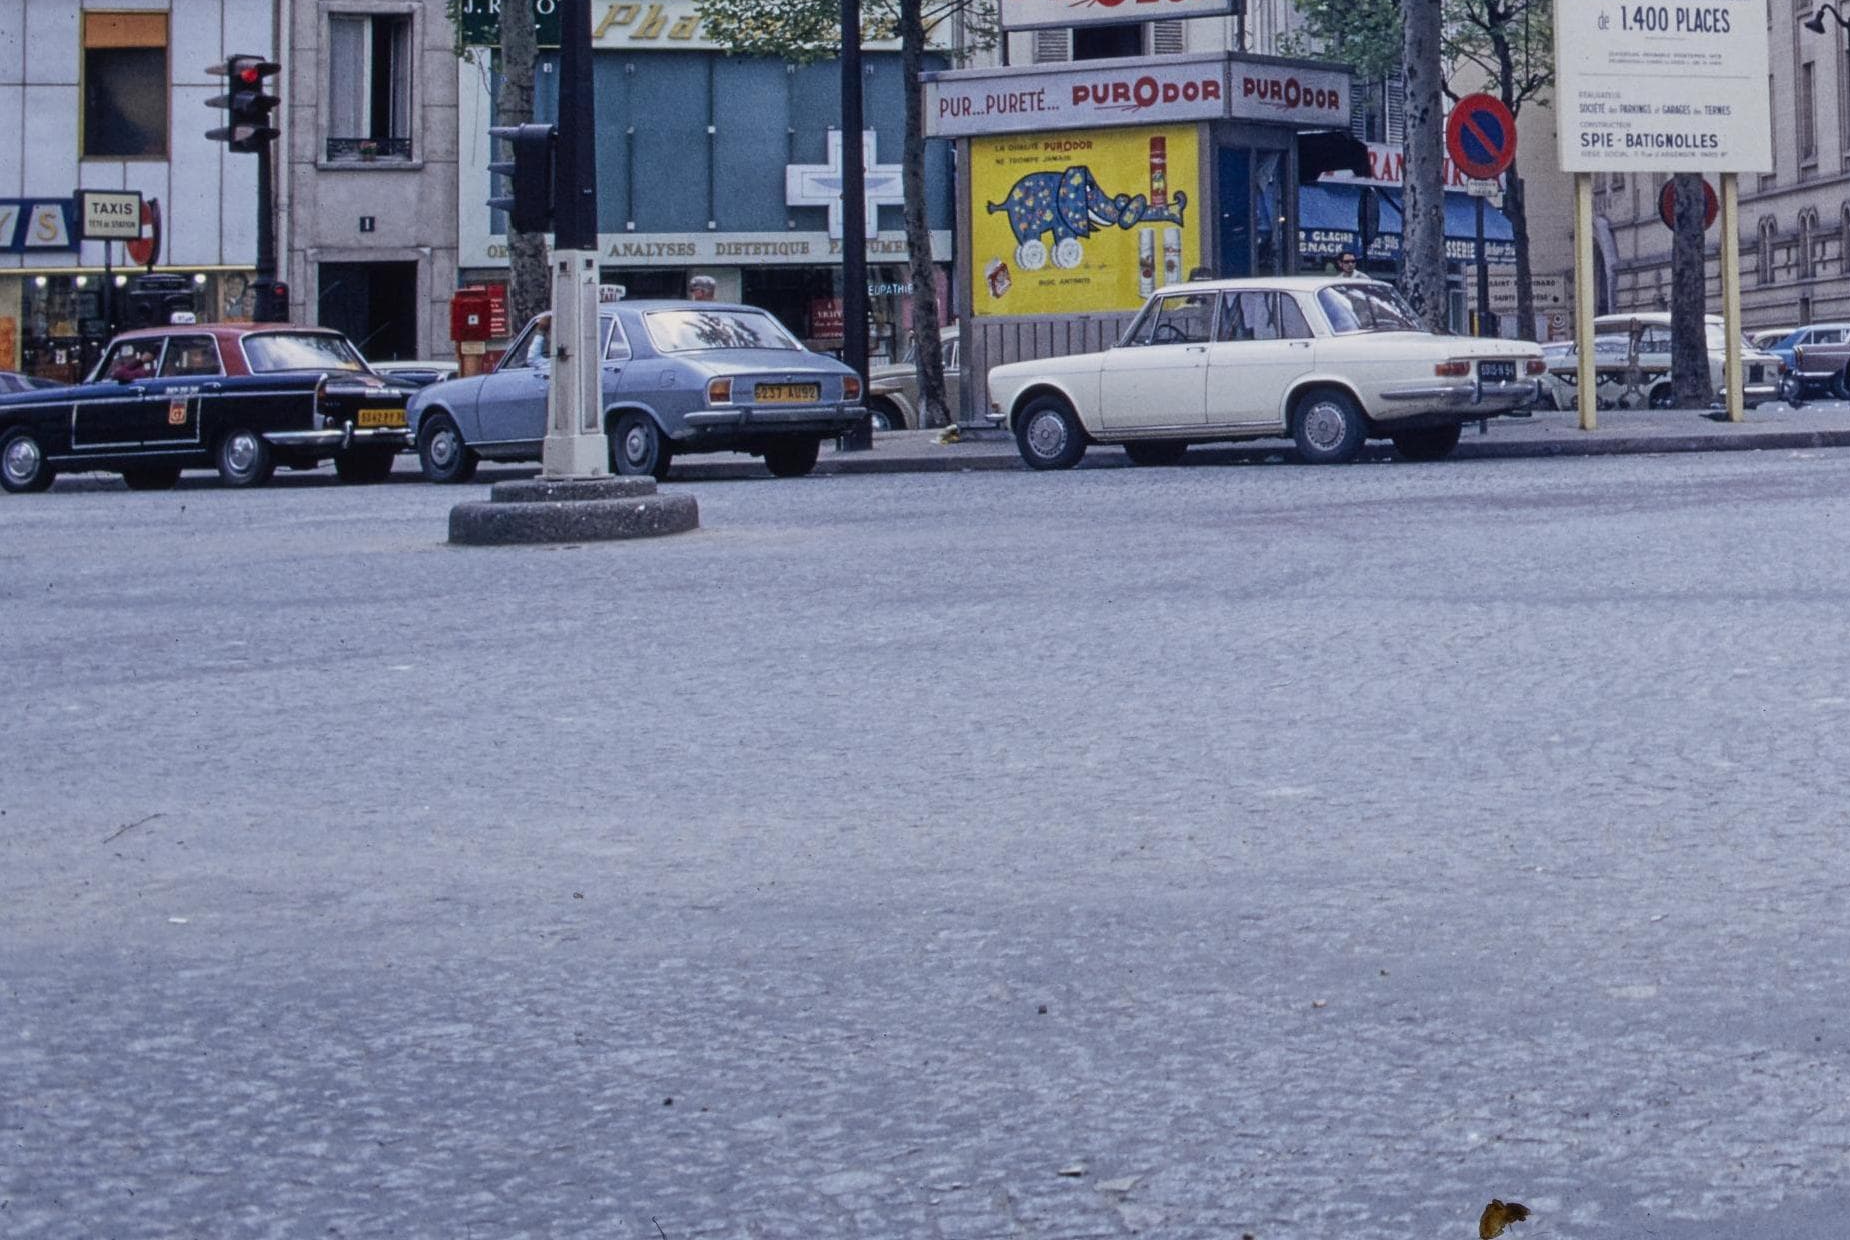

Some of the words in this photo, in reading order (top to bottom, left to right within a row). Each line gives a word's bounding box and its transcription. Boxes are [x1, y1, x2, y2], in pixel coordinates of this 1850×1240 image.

[1598, 10, 1610, 30] de
[1621, 6, 1669, 31] 1.400
[1676, 8, 1731, 33] PLACES
[1072, 76, 1220, 108] PURODOR
[1243, 76, 1340, 110] PURODOR
[1620, 104, 1651, 114] PARKINGS
[1662, 105, 1690, 115] GARAGES
[1704, 105, 1731, 116] TERNES
[1044, 140, 1093, 153] PURODOR
[1581, 132, 1614, 147] SPIE
[1626, 133, 1718, 149] BATIGNOLLES
[92, 202, 133, 215] TAXIS
[609, 243, 696, 257] ANALYSES
[1298, 242, 1343, 253] SNACK
[1446, 241, 1475, 259] SSERIE
